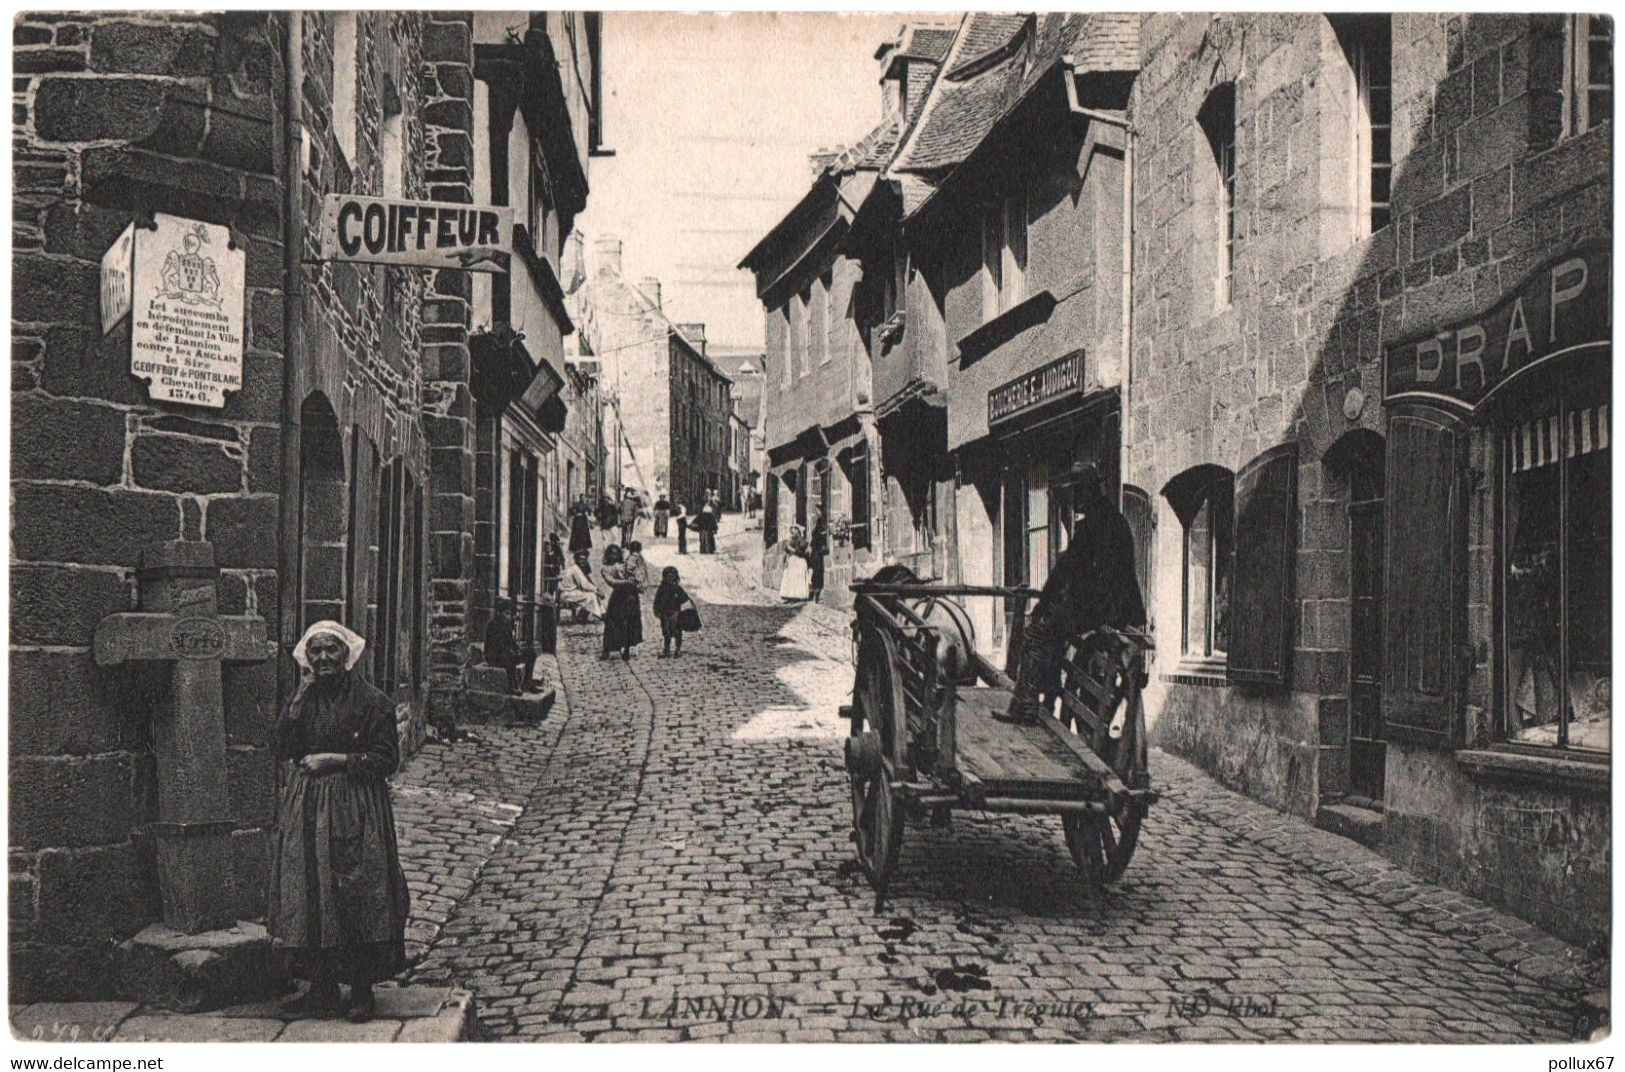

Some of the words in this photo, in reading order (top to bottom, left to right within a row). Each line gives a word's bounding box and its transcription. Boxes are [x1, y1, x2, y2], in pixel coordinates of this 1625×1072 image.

[337, 201, 500, 256] COIFFEUR
[137, 320, 148, 329] en
[206, 330, 216, 340] la
[219, 332, 240, 345] Ville
[136, 341, 173, 353] contre
[176, 345, 191, 356] les
[155, 332, 169, 342] de
[174, 335, 221, 352] Lannion
[133, 360, 179, 377] GEOFFROY
[166, 354, 177, 364] le
[184, 357, 211, 369] Sire
